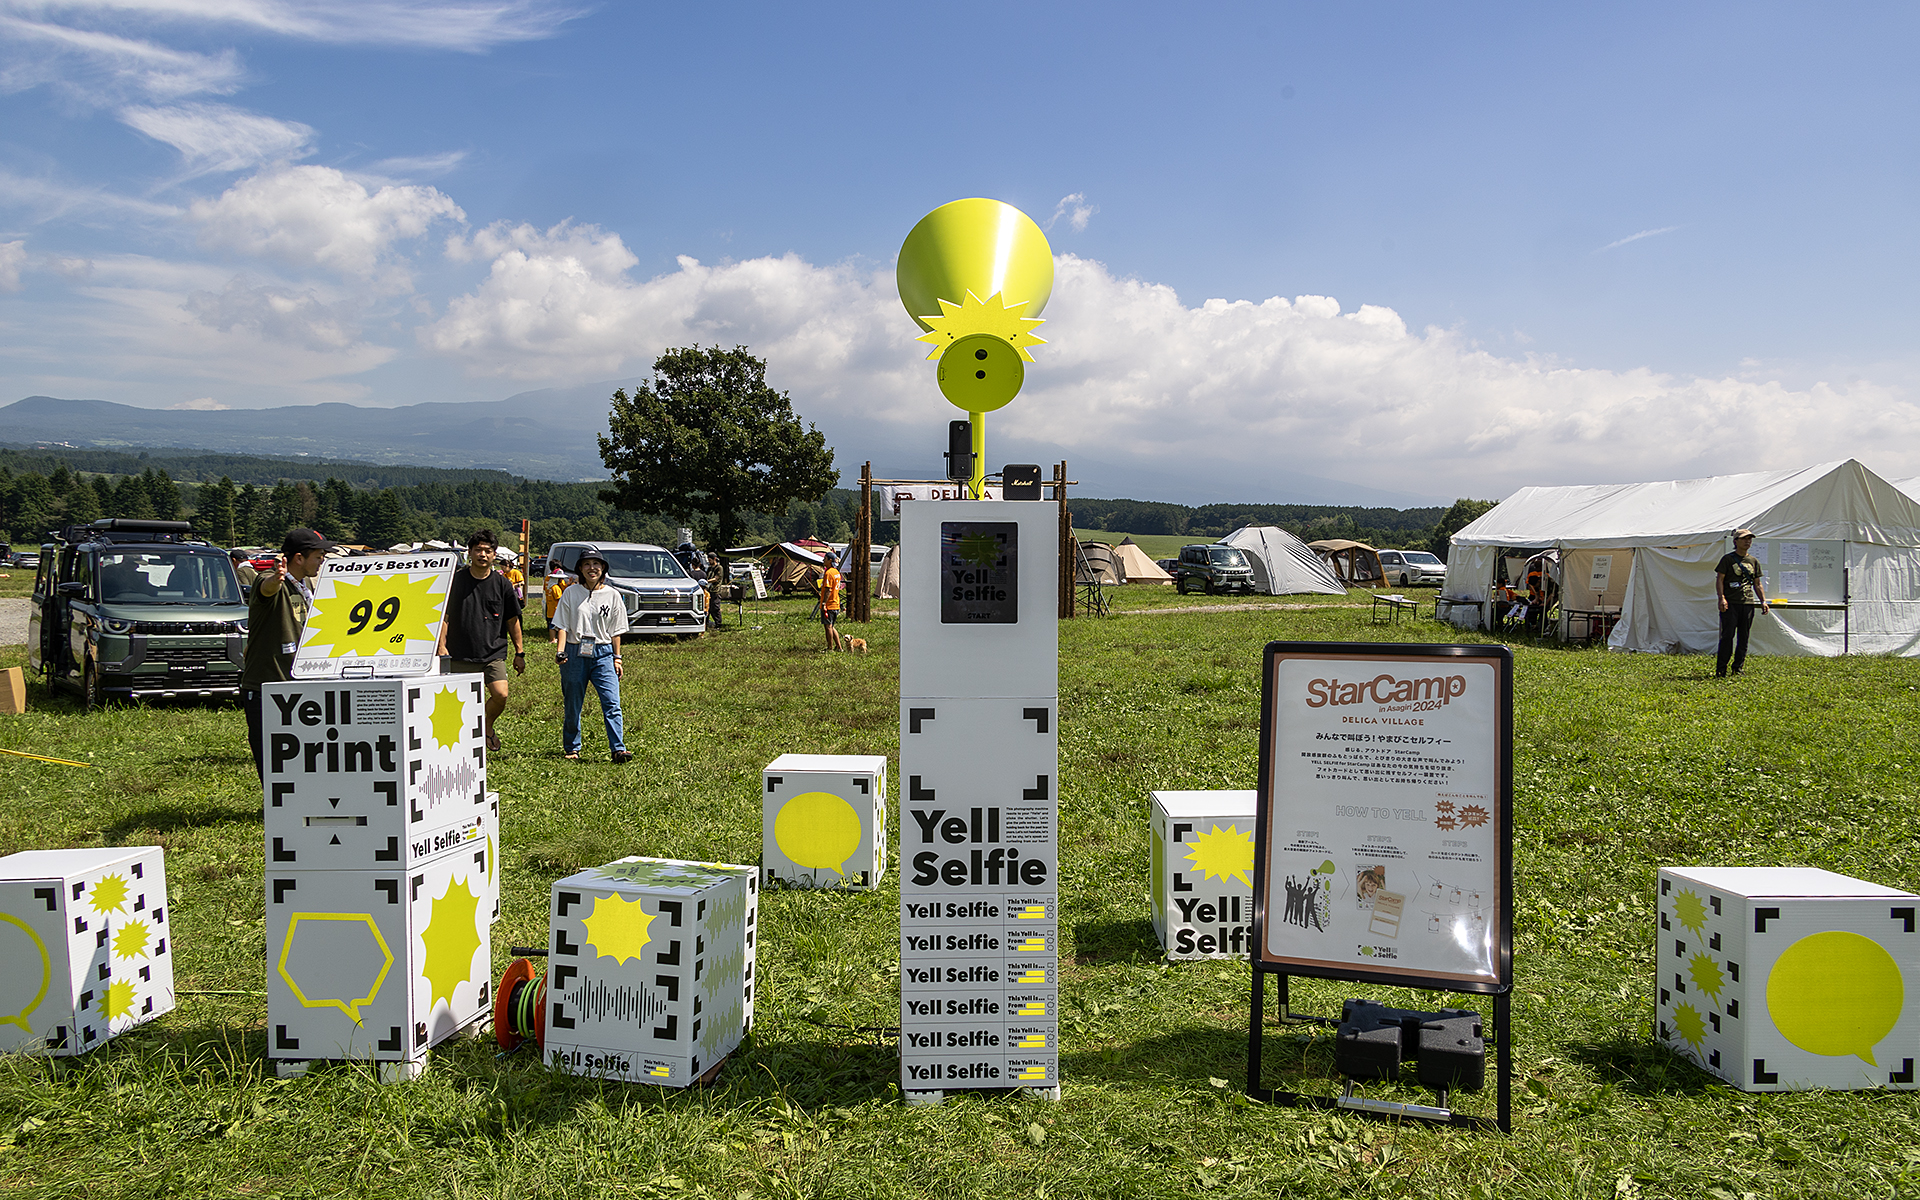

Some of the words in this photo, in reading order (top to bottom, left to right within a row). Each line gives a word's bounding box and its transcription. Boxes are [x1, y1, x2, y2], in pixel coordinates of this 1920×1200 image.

[931, 489, 993, 500] DELIA
[328, 561, 384, 574] Today's
[386, 559, 419, 570] Best
[421, 558, 449, 568] Yell
[952, 569, 988, 584] Yell
[952, 586, 1007, 601] Selfie
[346, 596, 401, 636] 99
[967, 612, 991, 620] START
[389, 634, 405, 643] dB
[1305, 673, 1467, 708] StarCamp
[270, 690, 351, 726] Yell
[1386, 703, 1412, 713] Asagiri
[1412, 700, 1443, 713] 2024
[1342, 716, 1378, 725] DELICA
[1381, 718, 1425, 726] VILLAGE
[270, 727, 397, 773] Print
[1335, 805, 1369, 818] HOW
[1371, 807, 1390, 819] TO
[1392, 808, 1428, 821] YELL
[910, 807, 1000, 844] Yell
[411, 838, 431, 858] Yell
[434, 829, 461, 851] Selfie
[910, 847, 1047, 887] Selfie
[906, 903, 941, 918] Yell
[946, 902, 999, 918] Selfie
[1174, 896, 1240, 923] Yell
[907, 935, 941, 950] Yell
[946, 934, 999, 950] Selfie
[1175, 926, 1252, 954] Selfi
[907, 967, 942, 983] Yell
[946, 966, 999, 982] Selfie
[907, 1000, 942, 1015] Yell
[946, 998, 1000, 1014] Selfie
[907, 1032, 942, 1047] Yell
[947, 1031, 1000, 1047] Selfie
[551, 1049, 581, 1067] Yell
[585, 1053, 630, 1072] Selfie
[908, 1064, 942, 1080] Yell
[947, 1063, 1000, 1079] Selfie
